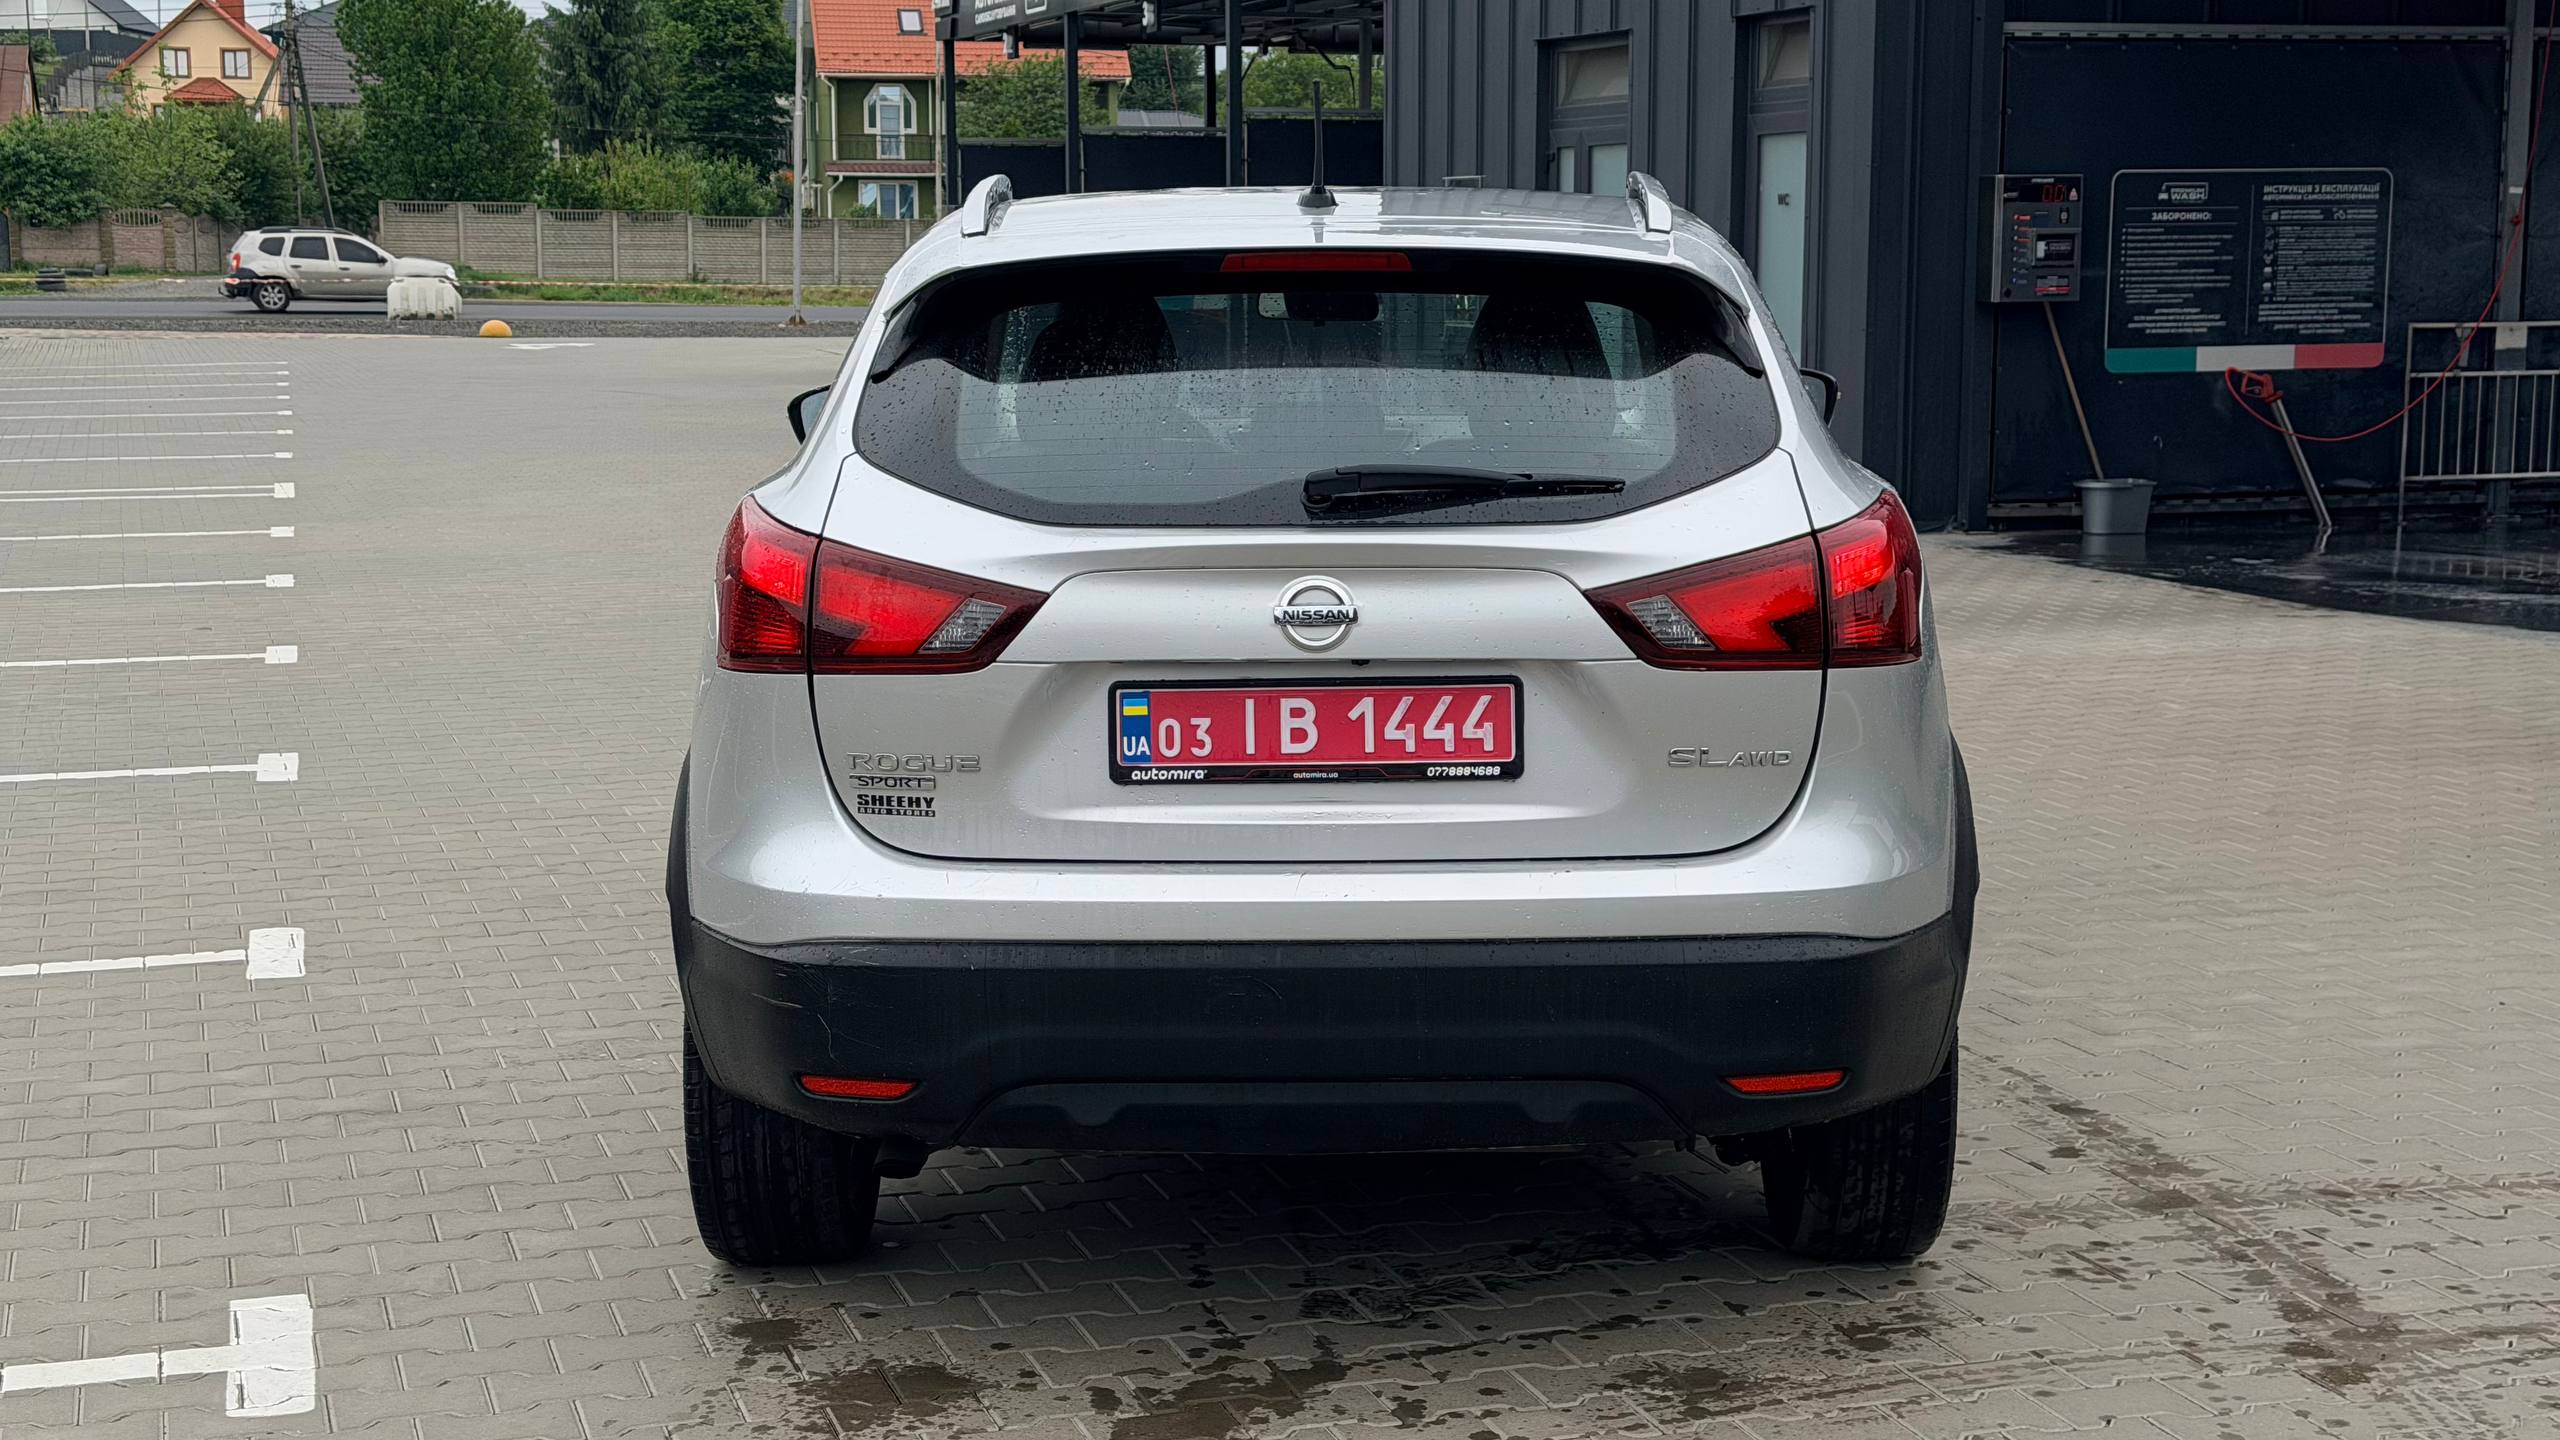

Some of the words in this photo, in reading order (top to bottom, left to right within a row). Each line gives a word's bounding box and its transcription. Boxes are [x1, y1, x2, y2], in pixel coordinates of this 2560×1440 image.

[2263, 184, 2312, 193] ІНСТРУКЦІЯ
[2321, 183, 2380, 193] ЕКСПЛУАТАЦІЇ
[1777, 193, 1790, 206] WC
[2171, 192, 2205, 200] WASH
[2151, 212, 2213, 221] ЗАБОРОНЕНО:
[1283, 609, 1350, 621] NISSAN
[1158, 717, 1213, 758] 03
[1347, 695, 1495, 754] 1444
[1123, 735, 1151, 757] UA
[847, 752, 982, 772] ROGUE
[1668, 747, 1728, 768] SL
[1728, 750, 1793, 767] AWD
[1131, 767, 1205, 780] automira
[1293, 771, 1339, 779] automira.ua
[1427, 766, 1501, 777] 0778884688
[858, 776, 924, 788] SPORT
[857, 794, 935, 809] SHEEHY
[858, 807, 887, 815] AUTO
[891, 808, 935, 817] STORES
